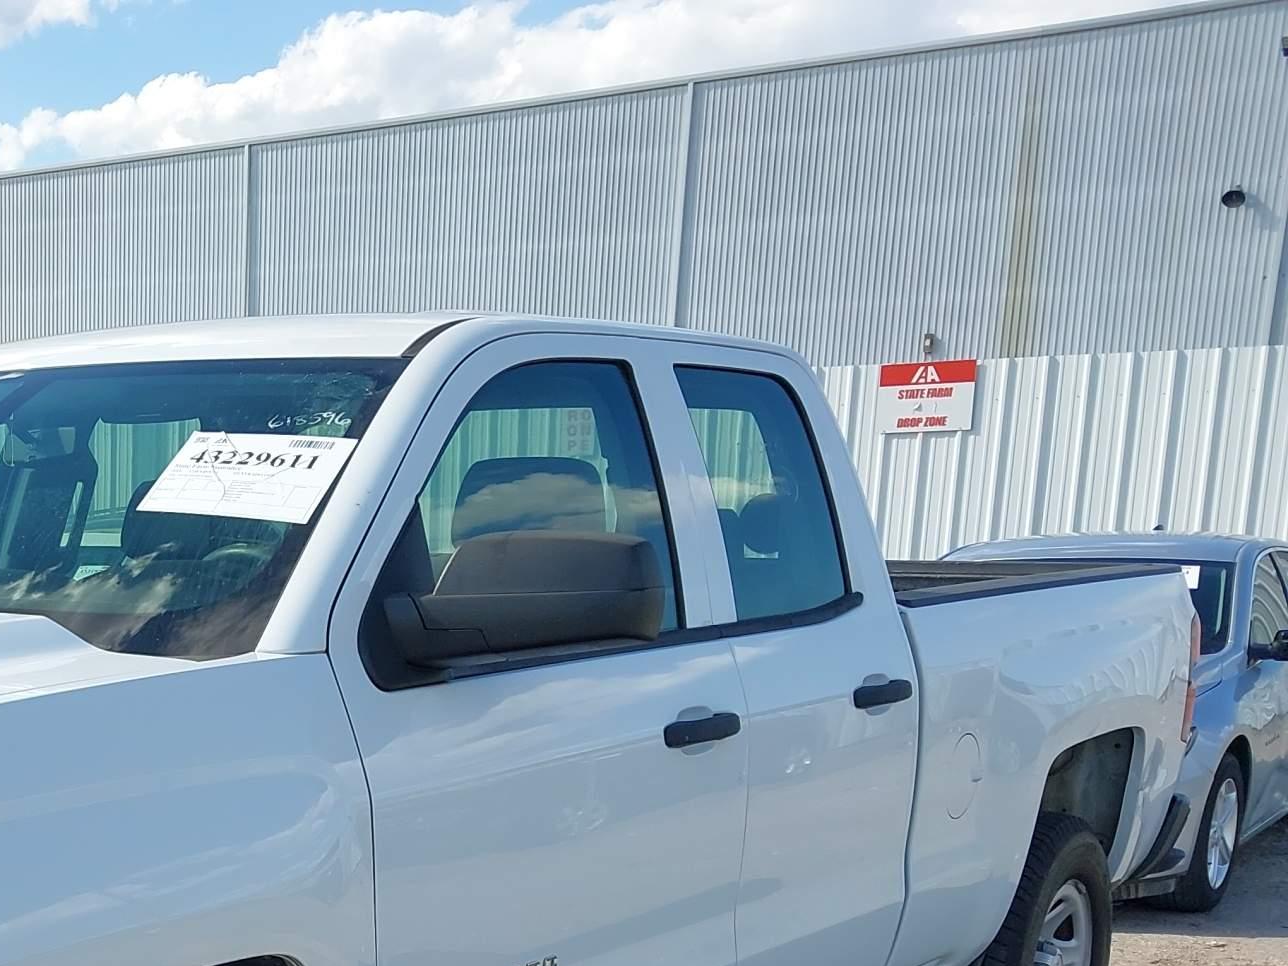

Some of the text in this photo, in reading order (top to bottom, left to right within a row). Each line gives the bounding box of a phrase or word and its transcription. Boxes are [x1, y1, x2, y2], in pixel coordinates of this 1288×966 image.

[898, 387, 953, 400] STATE FARM
[897, 416, 948, 429] DROP ZONE
[190, 449, 320, 470] 43229611
